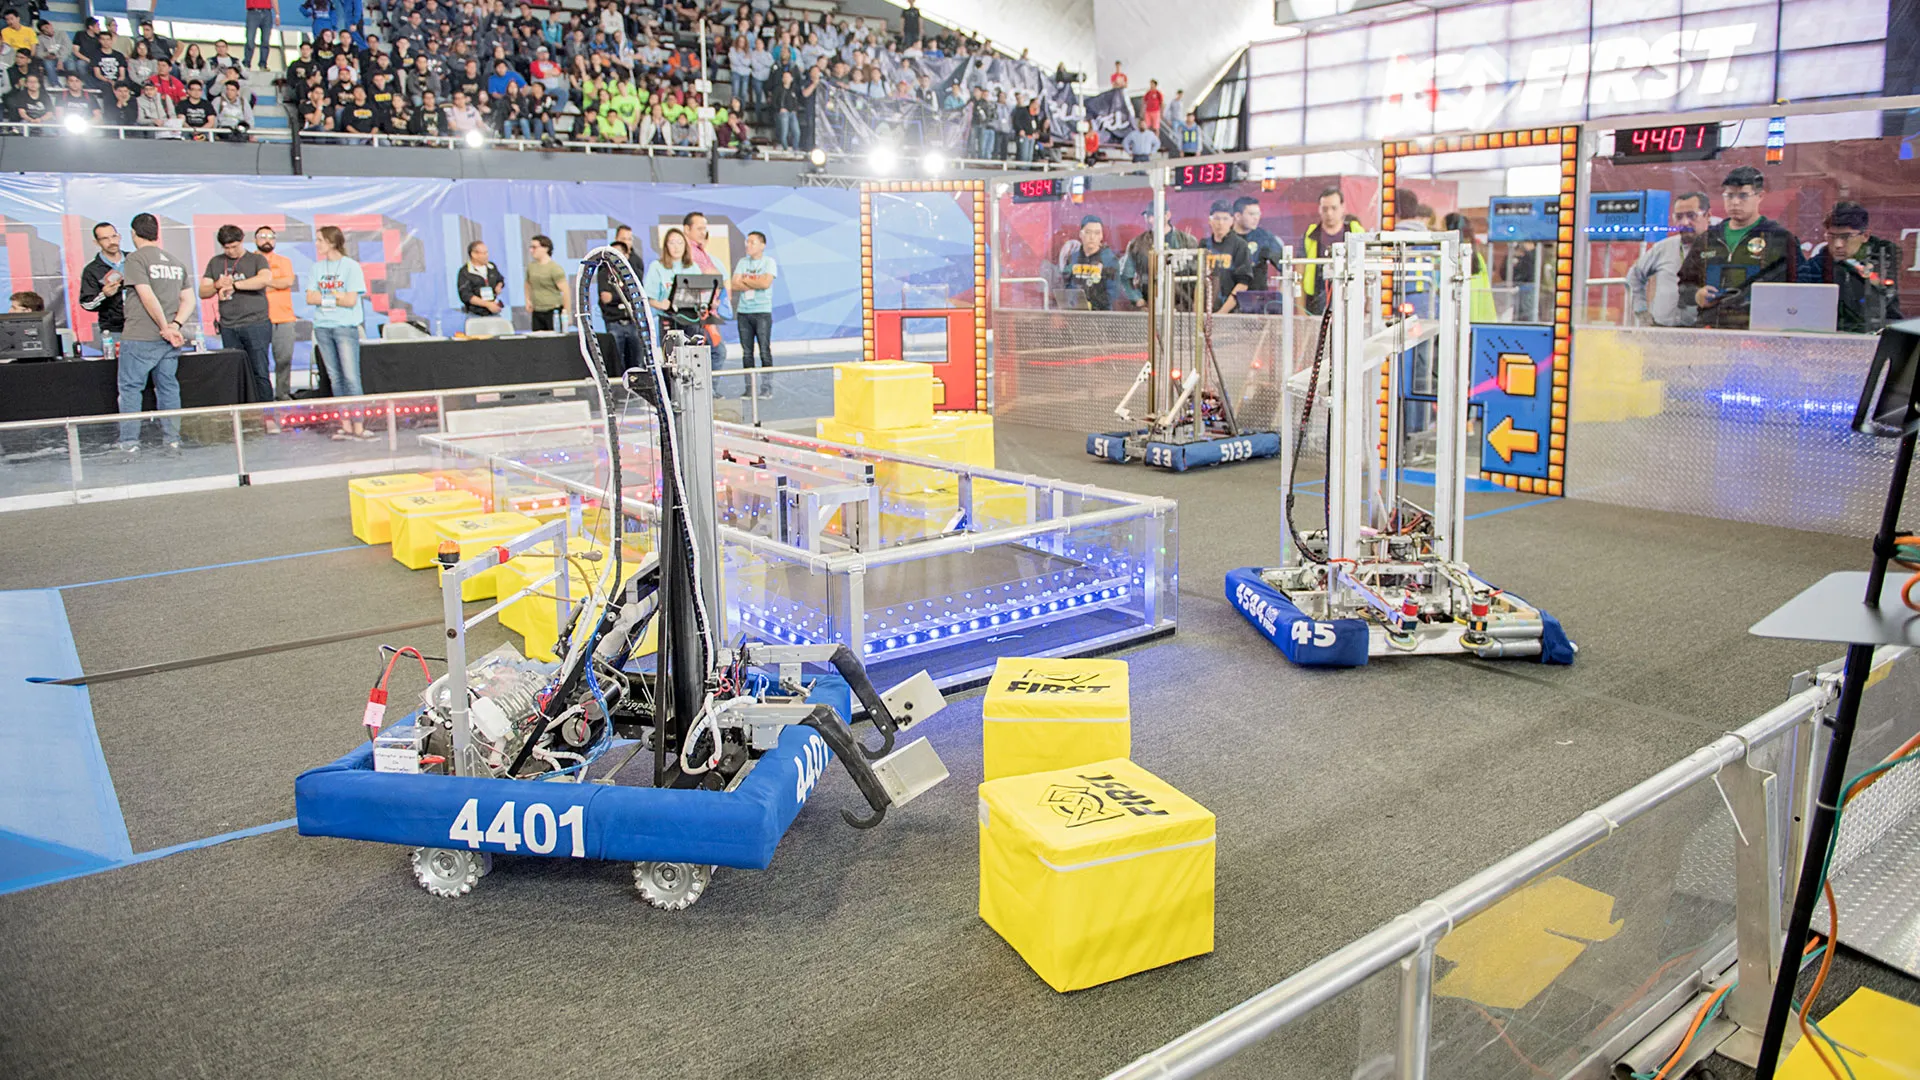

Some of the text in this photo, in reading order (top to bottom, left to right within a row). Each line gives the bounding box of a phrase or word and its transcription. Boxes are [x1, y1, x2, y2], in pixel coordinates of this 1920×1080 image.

[1631, 125, 1706, 152] 4401
[1183, 163, 1227, 184] 5133
[1020, 179, 1052, 196] 4584
[149, 264, 183, 280] STAFF
[1094, 438, 1109, 457] 51
[1152, 447, 1172, 467] 33
[1220, 440, 1252, 462] 5133
[1236, 583, 1267, 623] 4584
[1291, 620, 1336, 648] 45
[1005, 680, 1110, 694] FIRST
[1076, 773, 1169, 817] FIRST
[449, 798, 586, 858] 4401
